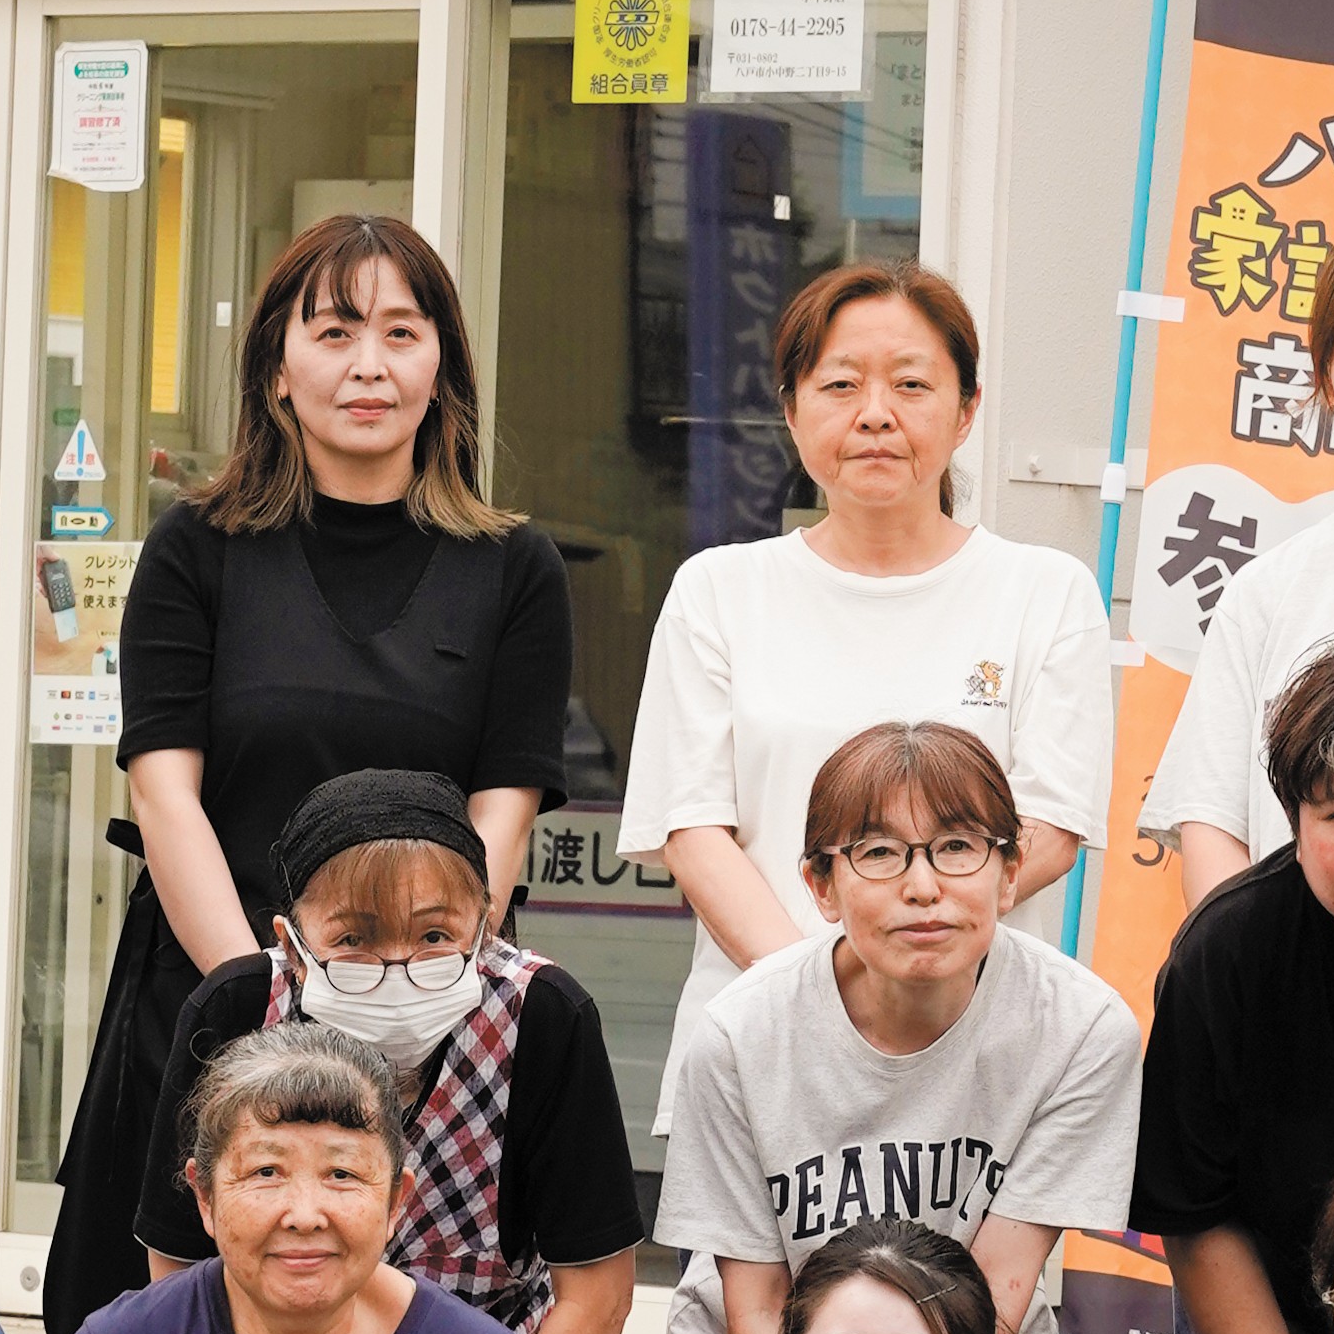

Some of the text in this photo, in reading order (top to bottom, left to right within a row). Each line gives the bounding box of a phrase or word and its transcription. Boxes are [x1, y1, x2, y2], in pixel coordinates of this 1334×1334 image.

[730, 16, 845, 37] 0178-44-2295
[590, 72, 669, 95] 組合員章
[83, 575, 117, 589] カード
[528, 827, 677, 889] 渡し
